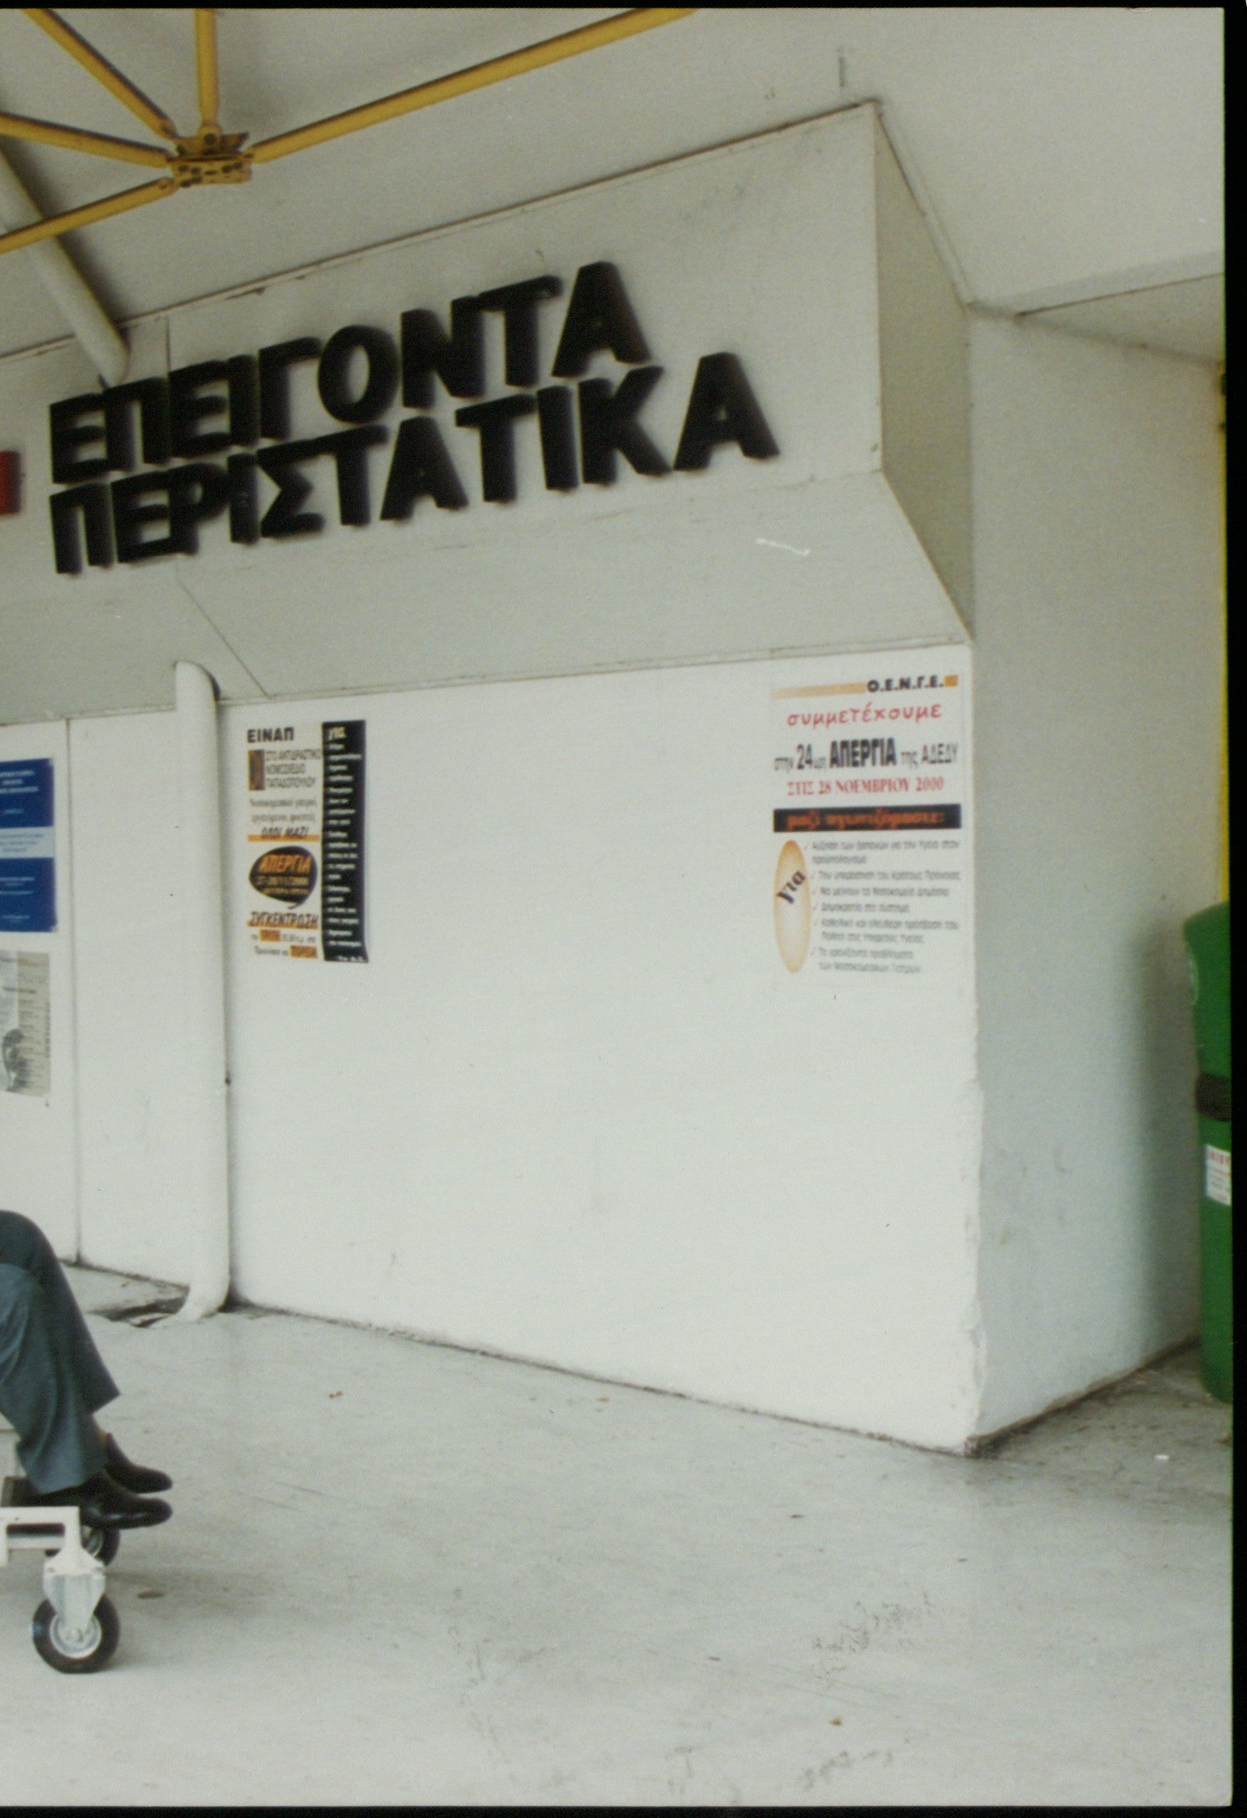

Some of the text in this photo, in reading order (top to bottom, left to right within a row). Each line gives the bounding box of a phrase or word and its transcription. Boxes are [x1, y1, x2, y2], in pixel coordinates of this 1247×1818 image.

[50, 261, 655, 485] ΕΠΕΙΓΟΝΤΑ
[50, 352, 781, 575] ΠΕΡΙΣΤΑΤΙΚΑ
[786, 702, 942, 729] συμμετέχουμε
[247, 727, 294, 743] ΕΙΝΑΠ
[829, 738, 897, 769] ΑΠΕΡΓΙΑ
[818, 780, 831, 795] 28
[836, 777, 909, 795] ΝΟΕΜΒΡΙΟΥ
[915, 776, 945, 793] 2000
